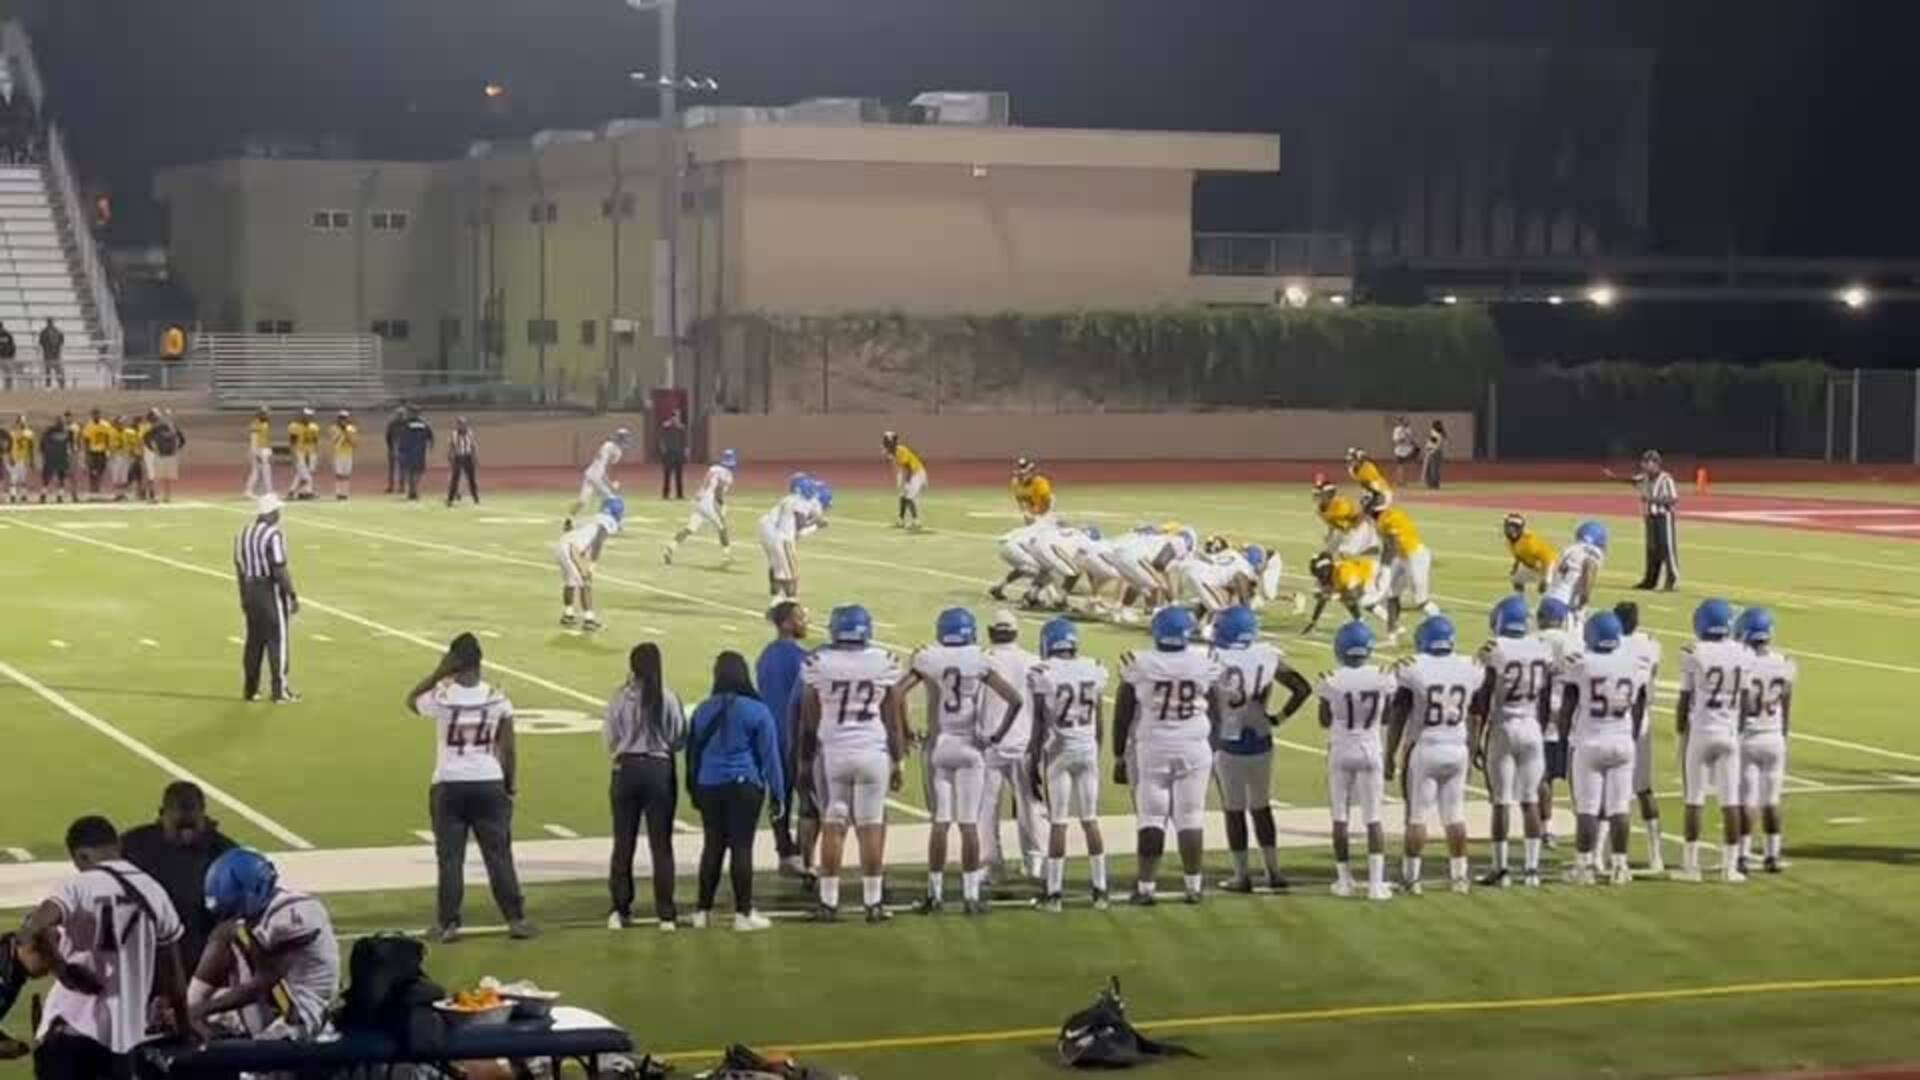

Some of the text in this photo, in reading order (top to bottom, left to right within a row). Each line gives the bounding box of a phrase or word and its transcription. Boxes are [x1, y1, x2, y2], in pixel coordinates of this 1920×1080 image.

[831, 679, 876, 724] 72
[944, 666, 962, 713] 3
[1055, 681, 1095, 728] 25
[1153, 679, 1195, 720] 78
[1424, 684, 1466, 727] 63
[1706, 666, 1741, 708] 21
[447, 707, 490, 755] 44
[1343, 690, 1379, 730] 17
